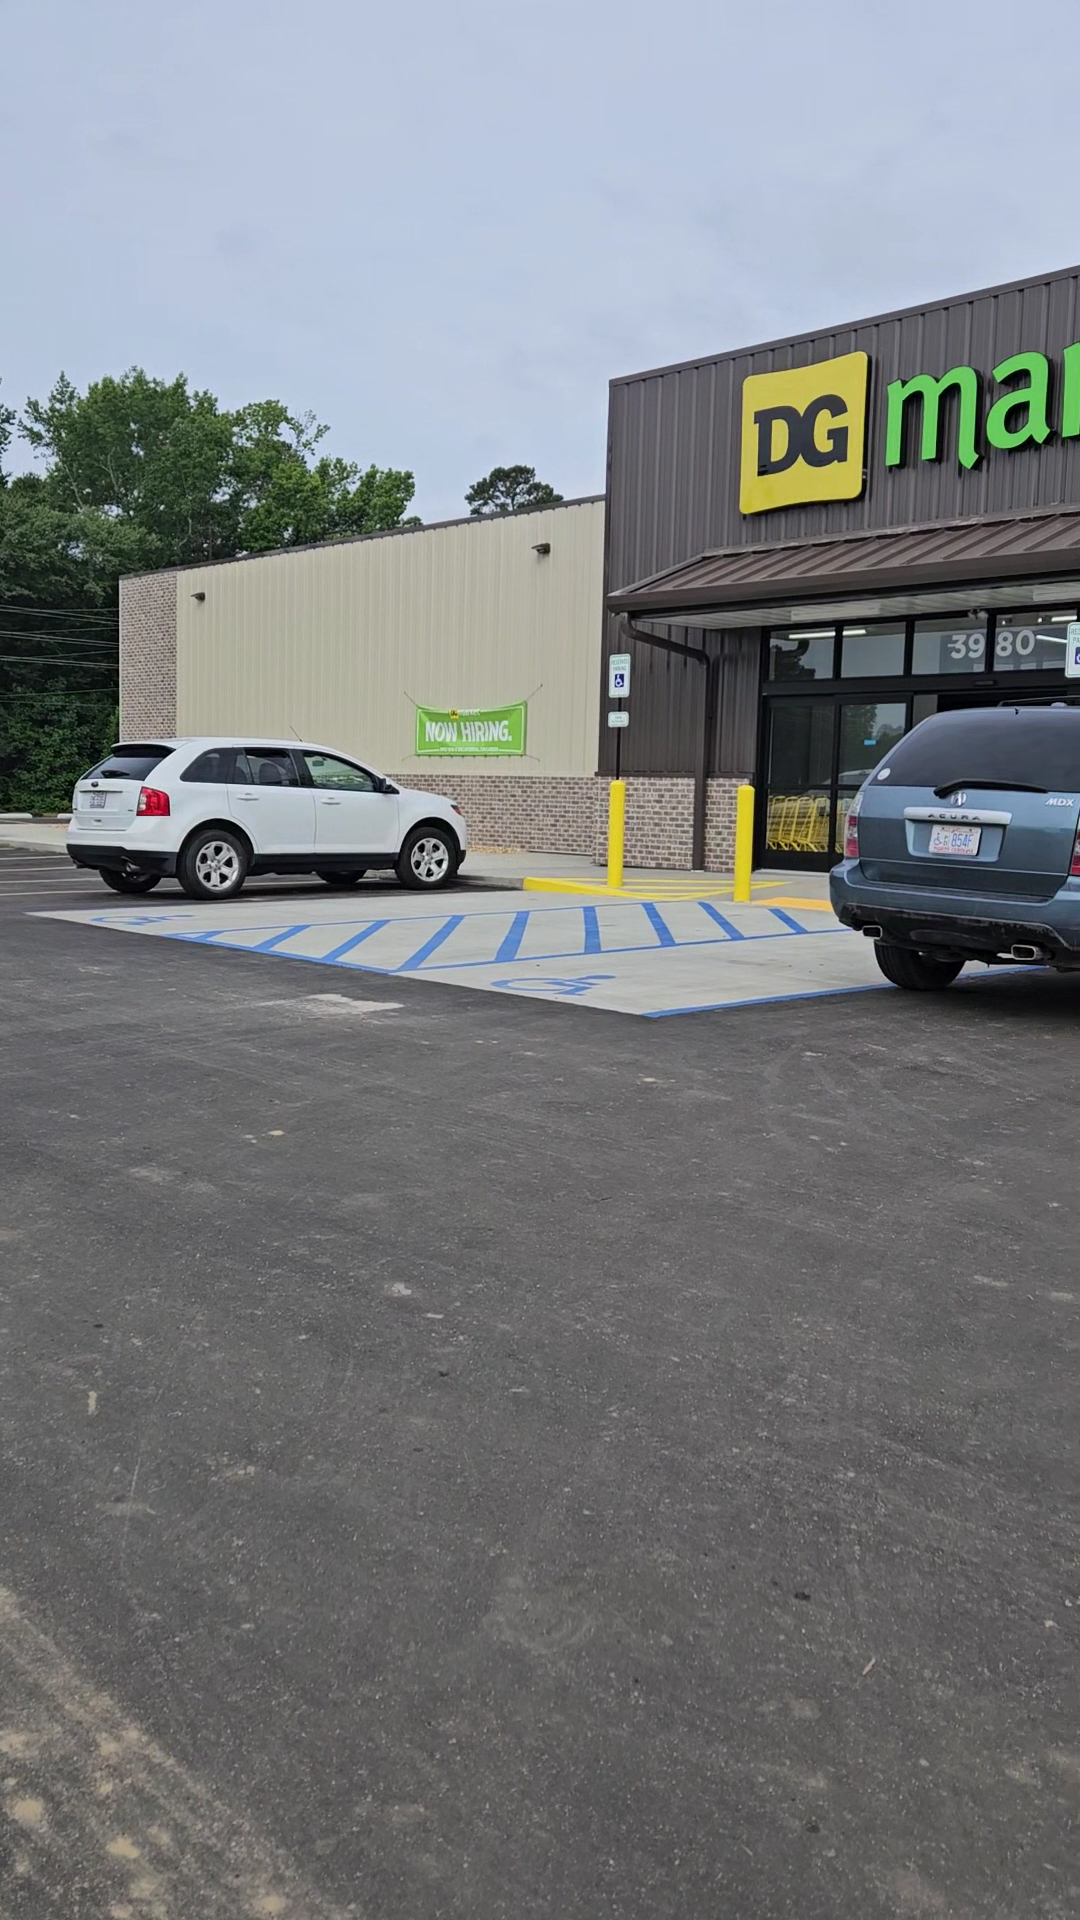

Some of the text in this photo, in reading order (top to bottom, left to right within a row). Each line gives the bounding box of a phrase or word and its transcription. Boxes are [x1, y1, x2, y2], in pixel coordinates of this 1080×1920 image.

[753, 393, 849, 477] DG
[949, 629, 1036, 659] 3980
[425, 721, 457, 742] NOW
[1045, 798, 1075, 807] MDX
